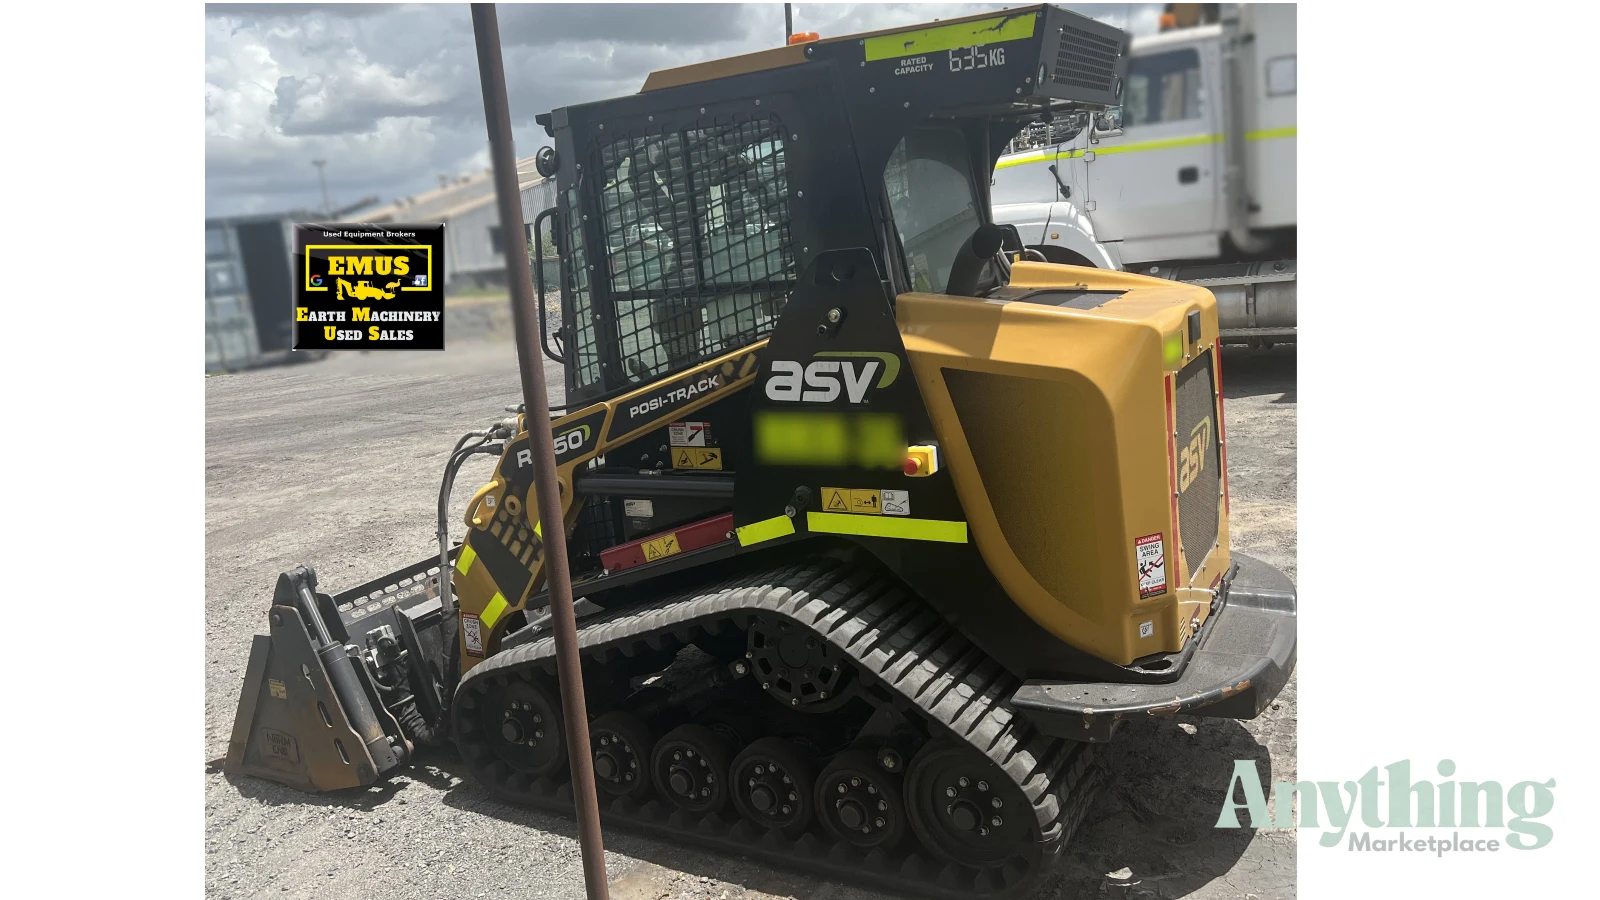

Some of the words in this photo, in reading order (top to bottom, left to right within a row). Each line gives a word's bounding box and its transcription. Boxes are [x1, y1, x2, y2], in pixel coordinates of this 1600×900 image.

[900, 56, 927, 67] RATED
[894, 63, 934, 76] CAPACITY
[629, 374, 720, 419] POSI-TRACK
[1140, 543, 1159, 552] SWING
[1142, 549, 1159, 557] AREA
